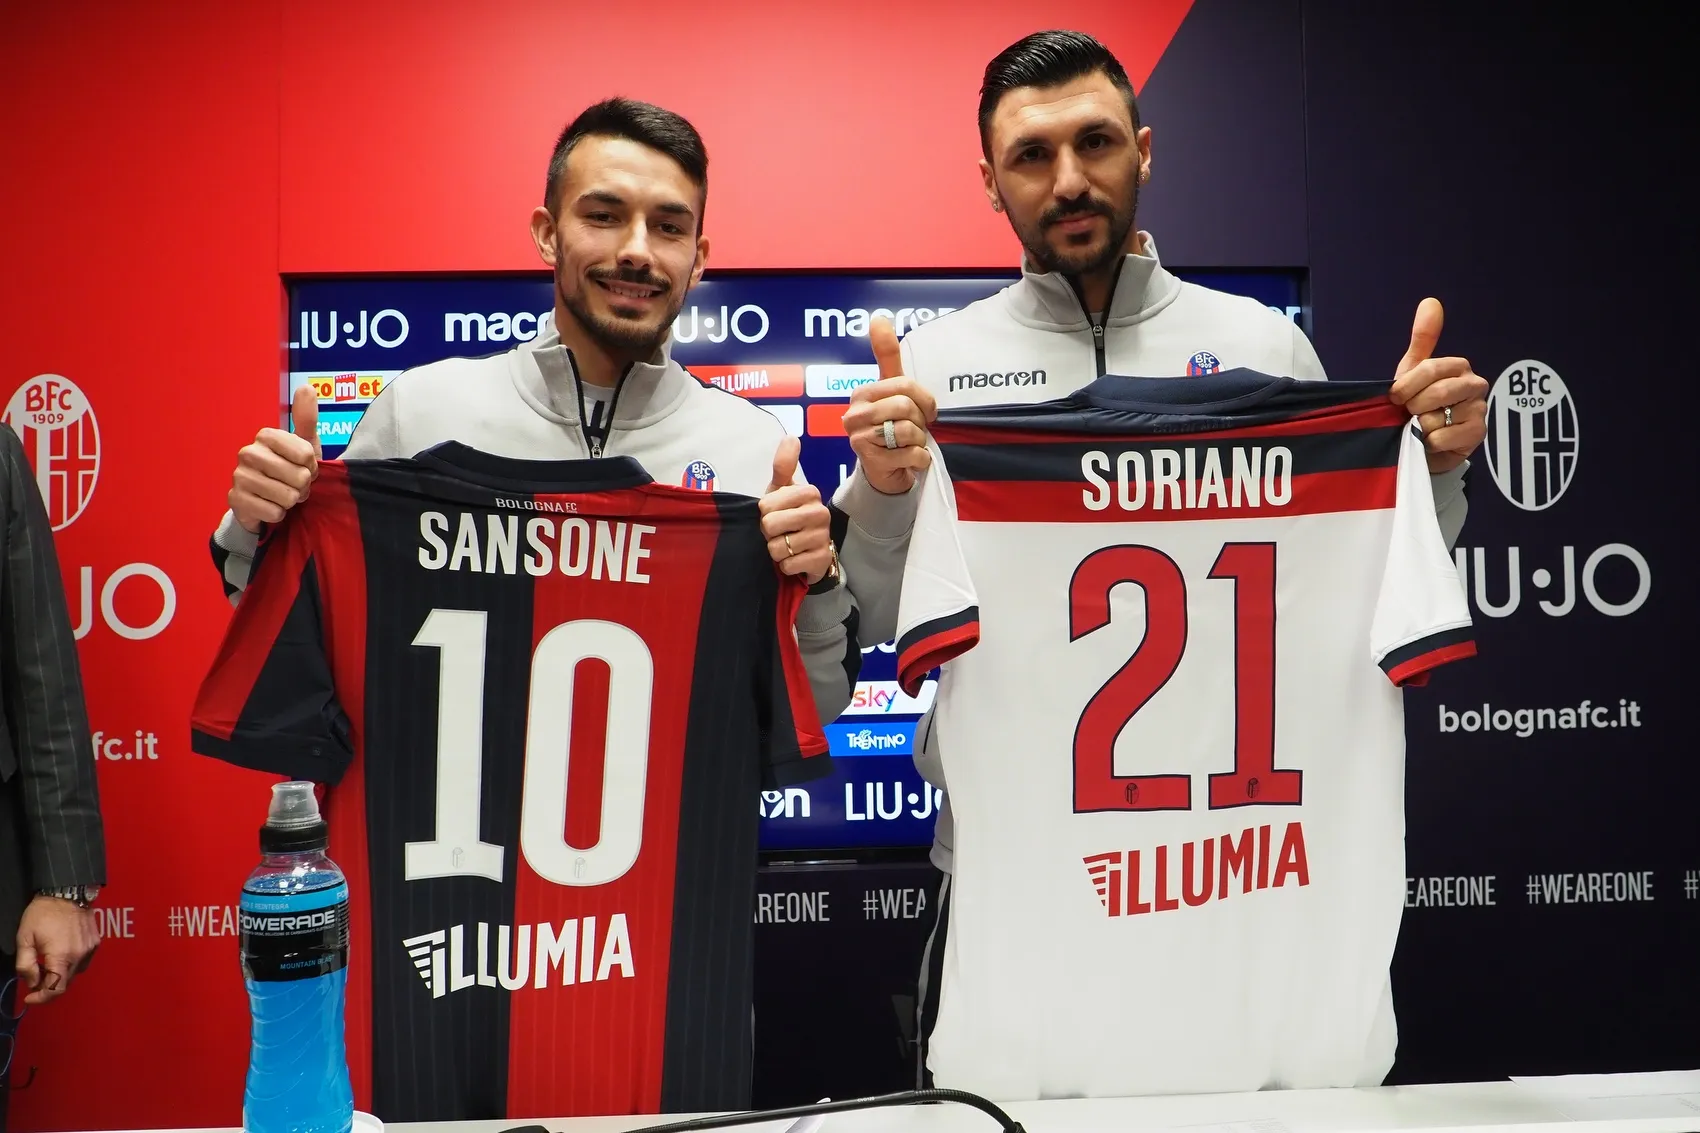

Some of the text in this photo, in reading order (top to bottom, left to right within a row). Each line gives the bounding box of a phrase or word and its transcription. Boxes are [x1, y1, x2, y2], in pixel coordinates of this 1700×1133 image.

[804, 308, 958, 338] maro
[1195, 352, 1216, 365] BFC
[949, 368, 1047, 393] macron
[1508, 366, 1552, 397] BFC
[25, 381, 73, 412] BFC
[1515, 397, 1545, 408] 1909
[32, 413, 64, 425] 1909
[692, 463, 711, 476] BFC
[1081, 446, 1293, 512] SORIANO
[495, 498, 565, 513] BOLOGNA
[565, 502, 578, 511] FC
[418, 511, 657, 584] SANSONE
[1069, 541, 1304, 814] 21
[853, 685, 898, 713] sky
[1439, 698, 1642, 738] bolognafc.it
[405, 608, 654, 887] 10
[846, 730, 906, 751] TRENTINO
[845, 781, 943, 821] LIU·J
[1526, 871, 1655, 905] #WEAREONE
[168, 905, 240, 938] #WEA
[239, 909, 336, 932] POWERADE
[280, 961, 316, 970] MOUNTAIN
